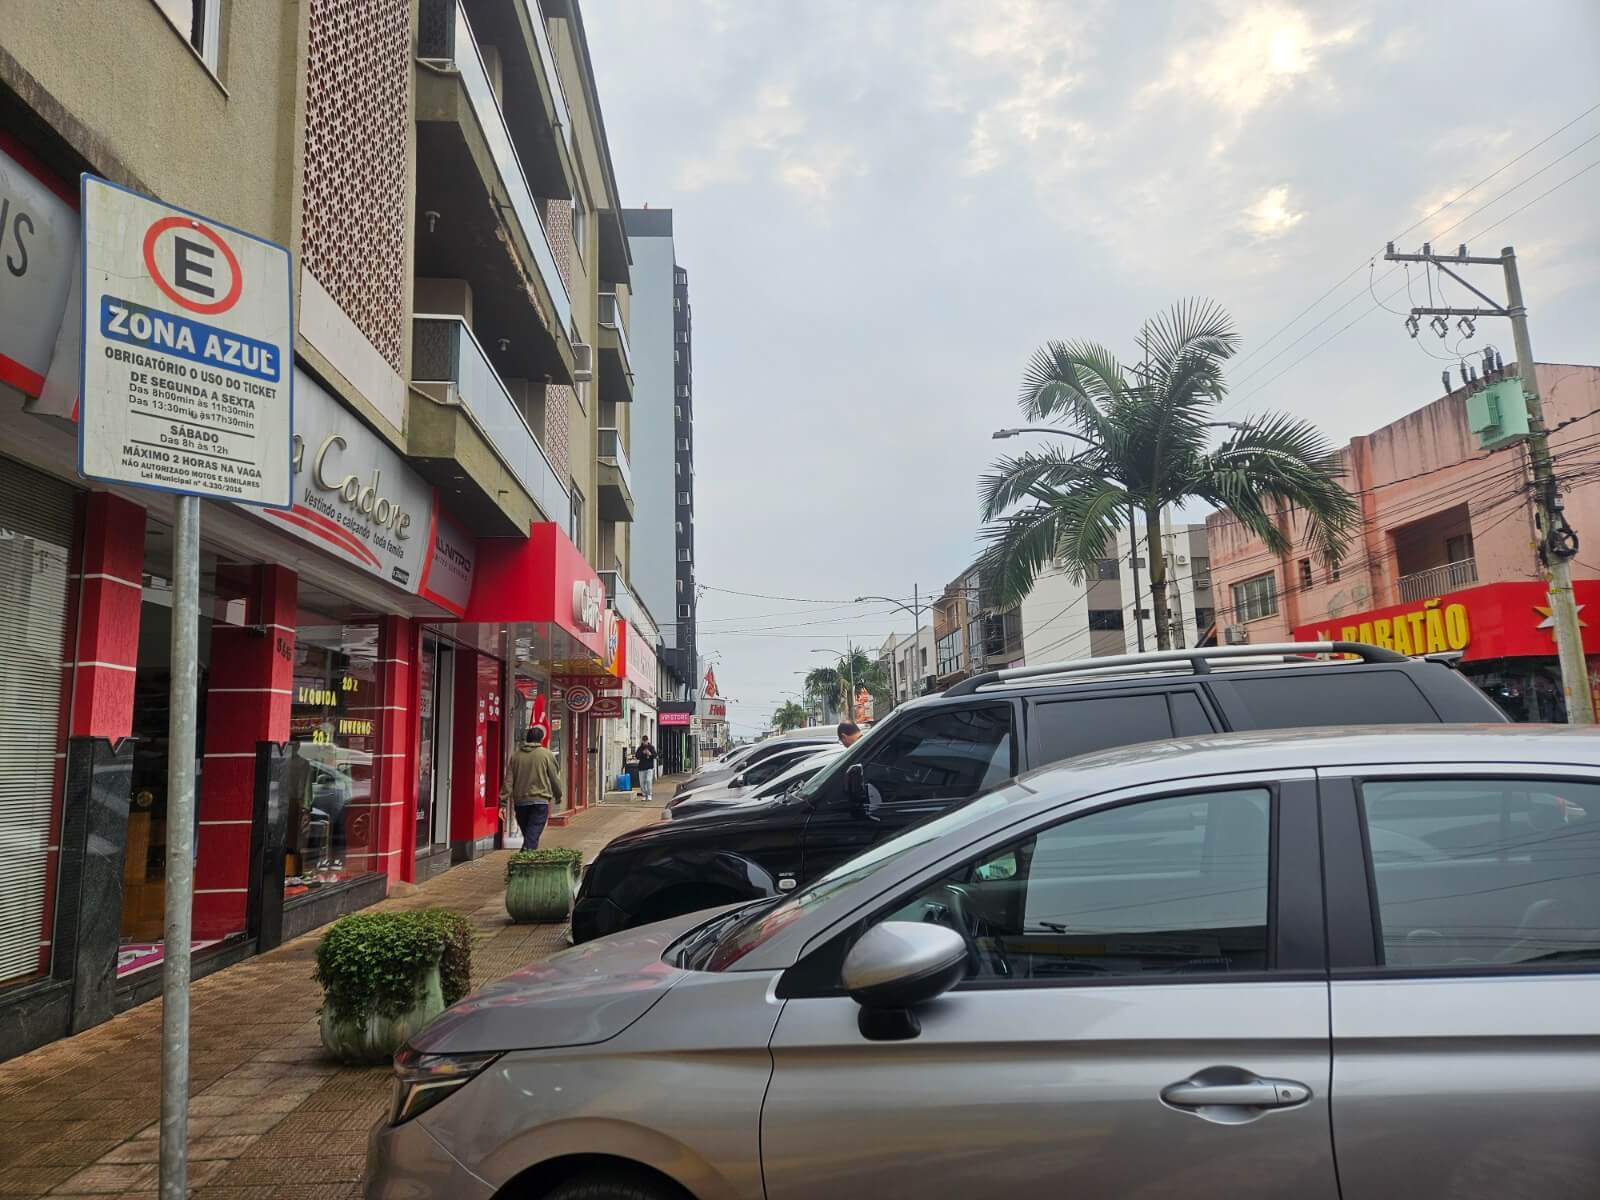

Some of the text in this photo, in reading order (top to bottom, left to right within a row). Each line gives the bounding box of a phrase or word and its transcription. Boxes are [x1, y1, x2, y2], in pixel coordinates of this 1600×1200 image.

[175, 236, 214, 298] E
[108, 305, 275, 376] ZONA AZUL
[105, 346, 277, 399] OBRIGATÓRIO O USO DO TICKET
[128, 394, 148, 407] Das
[128, 383, 149, 396] Das
[152, 387, 195, 406] 8h00min
[212, 401, 255, 419] 11h30min
[130, 371, 256, 410] DE SEGUNDA A SEXTA
[160, 434, 180, 447] Das
[182, 438, 194, 450] 8h
[212, 444, 228, 456] 12h
[170, 424, 220, 444] SÁBADO
[122, 458, 140, 469] NÃO
[140, 460, 190, 476] AUTORIZADO
[192, 470, 216, 482] MOTOS
[224, 476, 260, 488] SIMILARES
[123, 444, 262, 479] MÁXIMO 2 HORAS NA VAGA
[141, 470, 153, 480] Lei
[155, 472, 192, 487] Municipal
[314, 434, 411, 540] Cadore
[304, 488, 336, 519] Vestindo
[336, 512, 342, 524] e
[372, 533, 387, 550] toda
[1342, 598, 1470, 660] BARATÃO
[299, 686, 336, 706] LIQUIDA
[340, 720, 371, 735] INVERNO
